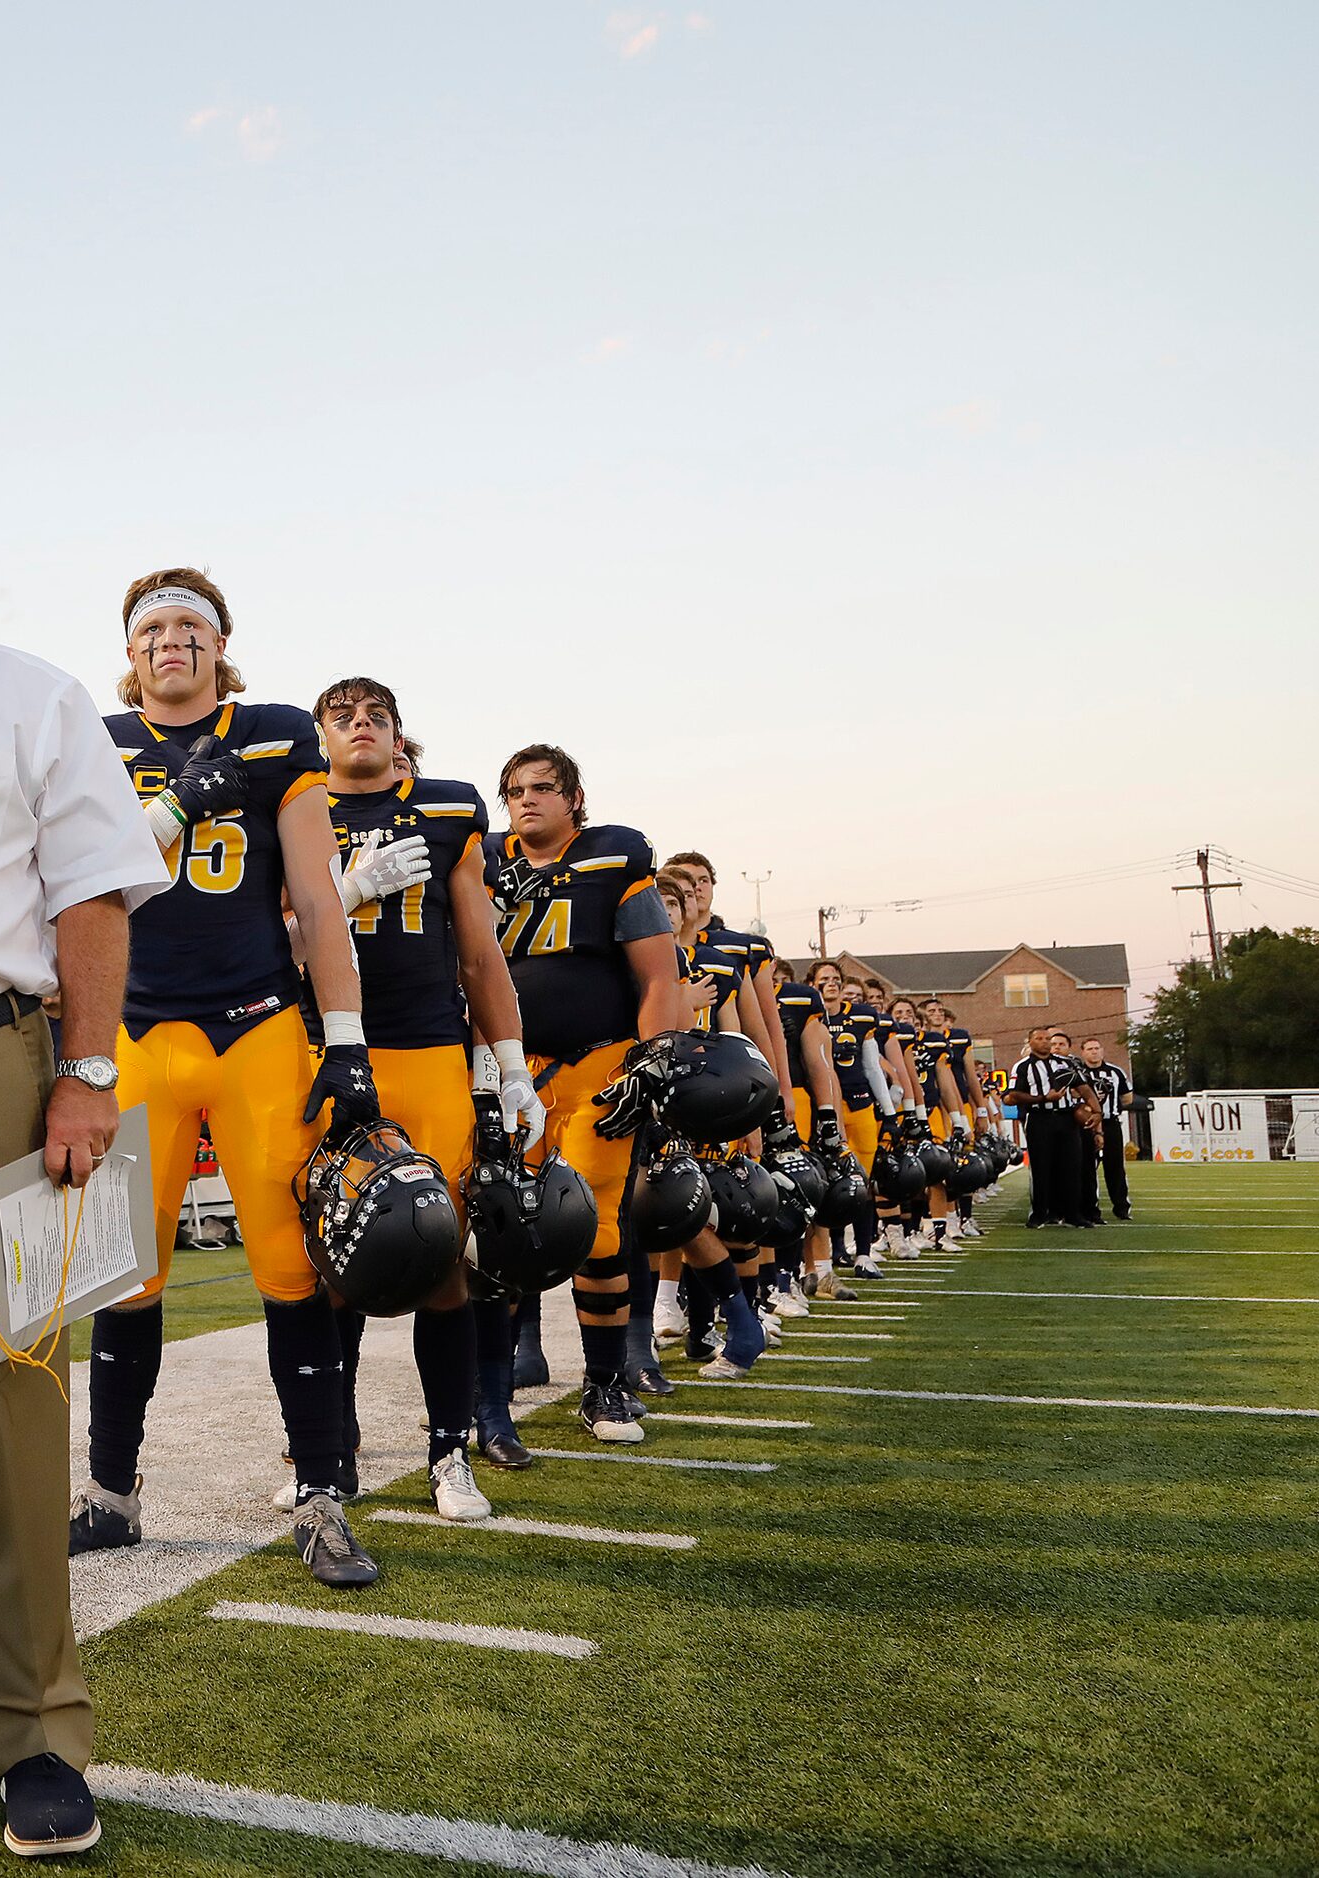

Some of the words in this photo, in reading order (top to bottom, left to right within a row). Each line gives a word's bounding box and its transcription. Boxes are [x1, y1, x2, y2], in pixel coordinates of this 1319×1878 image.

[162, 807, 248, 894] 5
[498, 899, 572, 957] 74
[1177, 1102, 1242, 1131] AVON
[1169, 1146, 1194, 1160] Go
[1200, 1147, 1256, 1160] Scots
